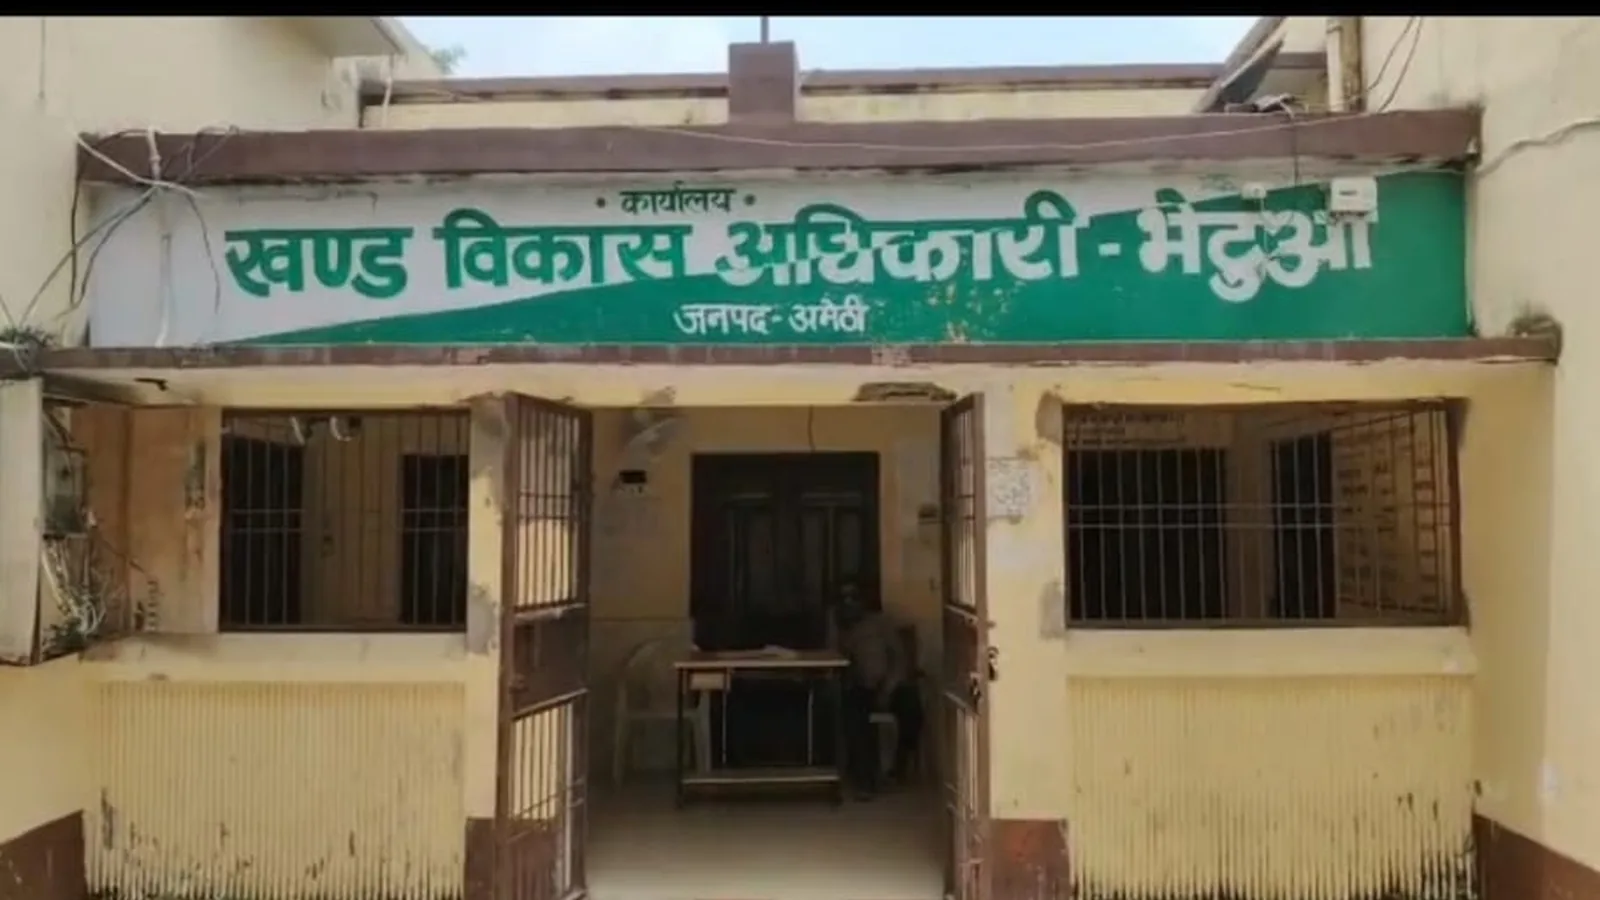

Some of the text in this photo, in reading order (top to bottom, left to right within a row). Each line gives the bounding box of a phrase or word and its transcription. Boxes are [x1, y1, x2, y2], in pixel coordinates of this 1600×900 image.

[619, 180, 737, 215] कार्यालय
[224, 226, 414, 298] खण्ड
[432, 208, 693, 289] विकास
[714, 190, 1090, 287] अधिकारी
[1136, 188, 1379, 302] भेटुआ
[788, 294, 870, 335] अमेठी
